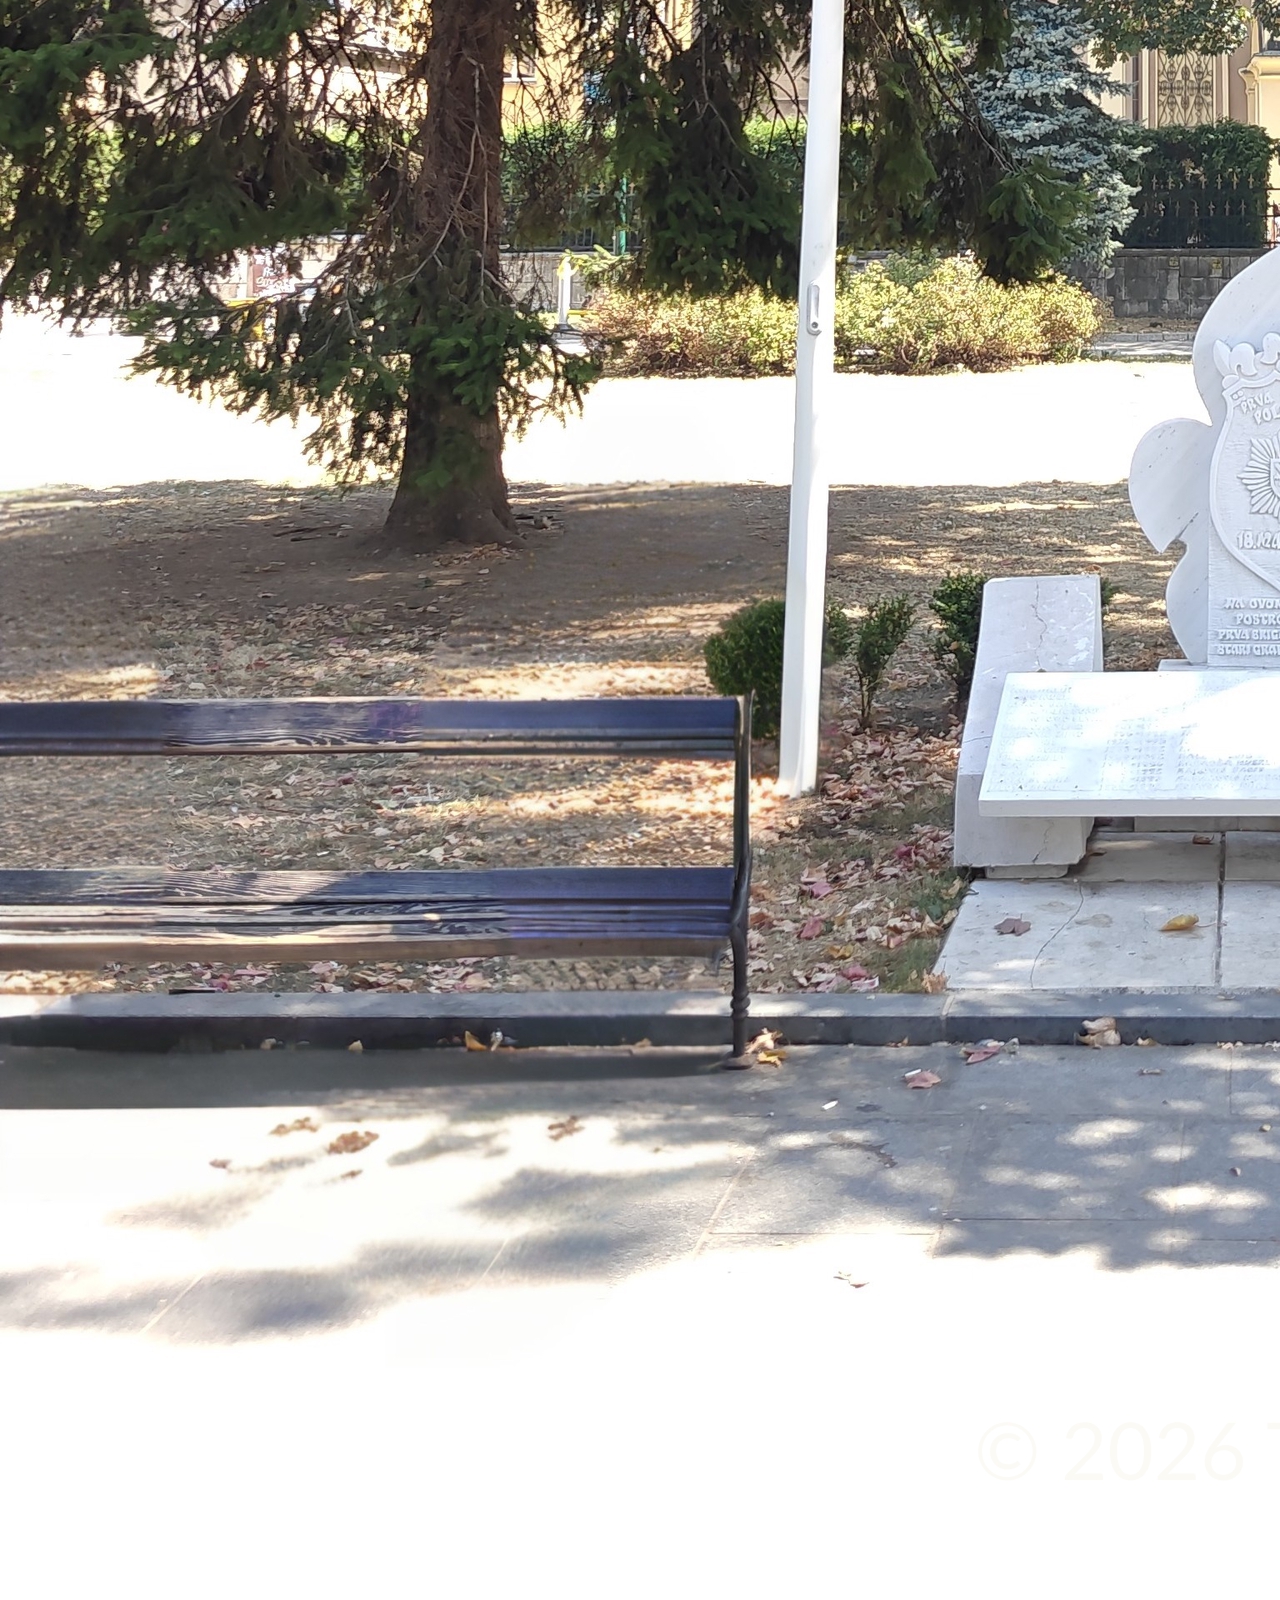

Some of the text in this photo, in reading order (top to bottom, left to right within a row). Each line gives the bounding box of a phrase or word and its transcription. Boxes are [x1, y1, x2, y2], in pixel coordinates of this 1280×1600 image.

[1241, 392, 1274, 414] PRVA
[1223, 598, 1245, 609] NA
[1218, 629, 1250, 641] PRVA
